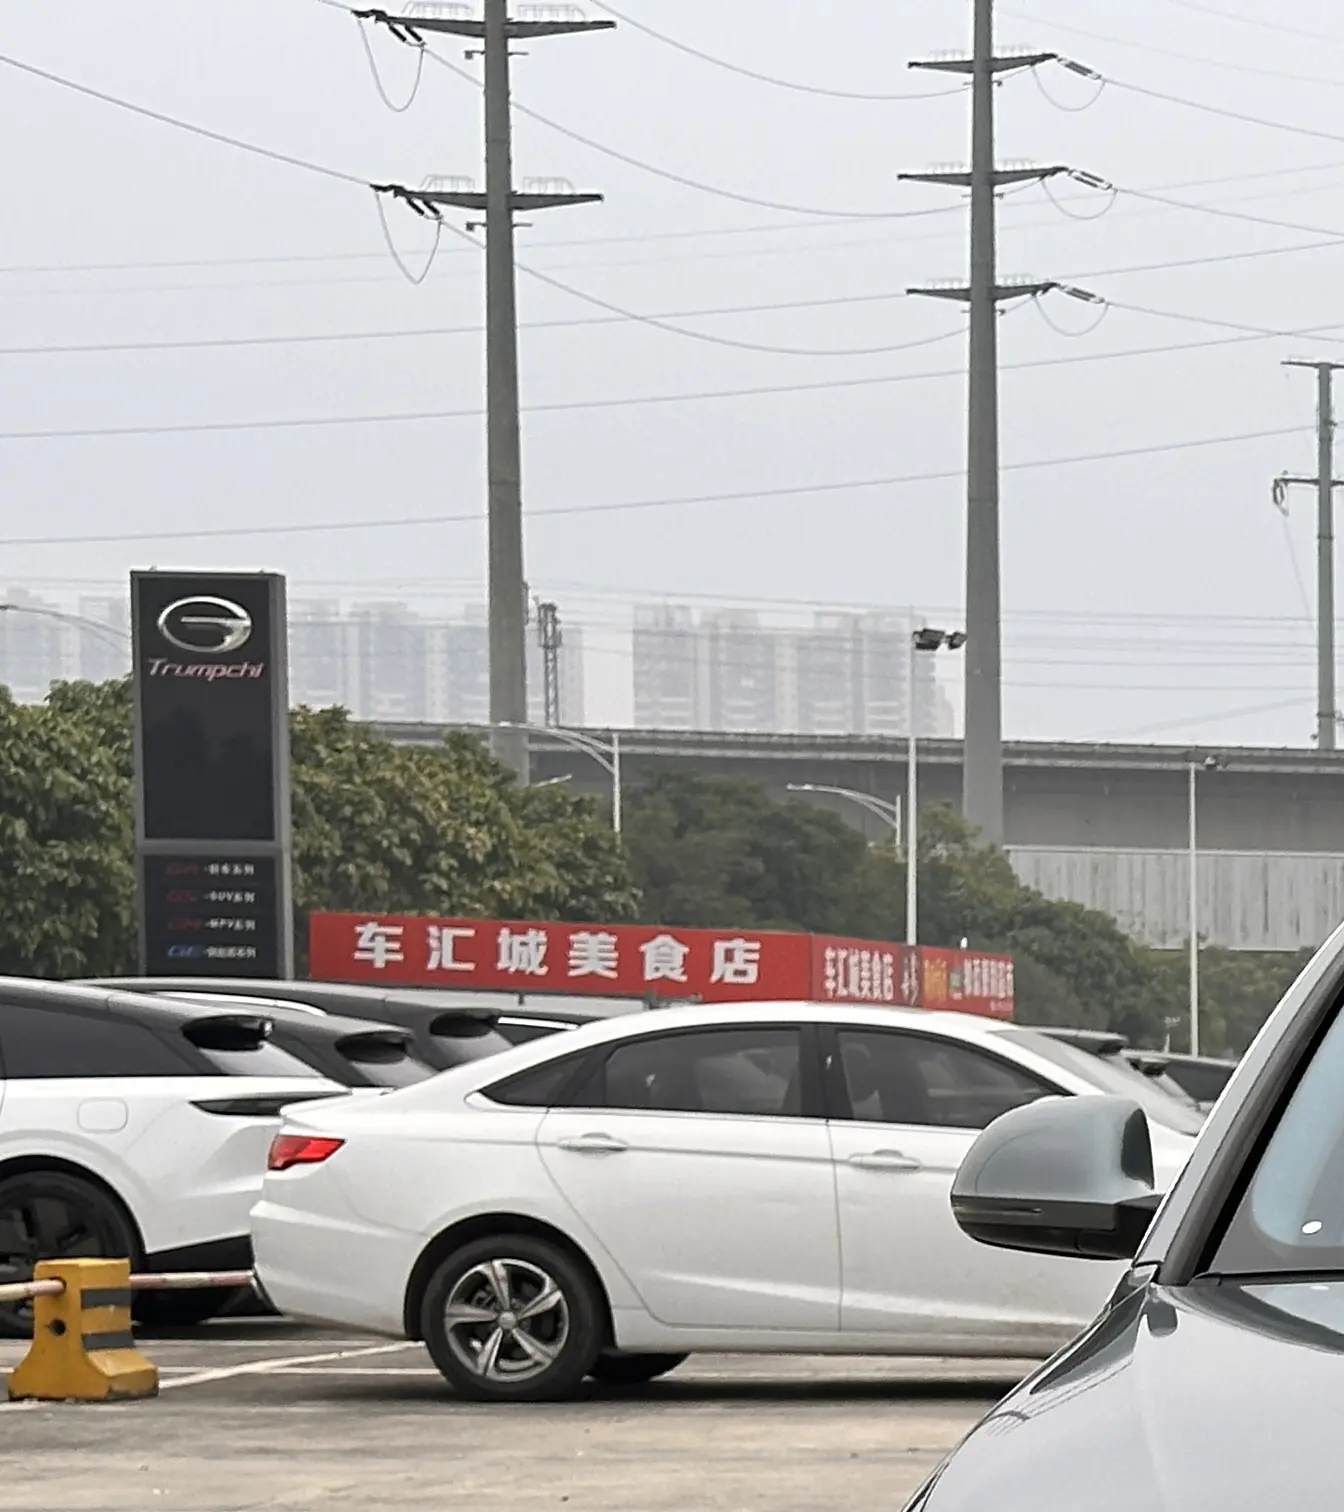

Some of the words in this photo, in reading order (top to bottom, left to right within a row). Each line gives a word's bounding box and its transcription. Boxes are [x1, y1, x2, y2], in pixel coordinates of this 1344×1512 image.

[148, 658, 264, 682] Trumpchi
[354, 921, 762, 985] 车汇城美食店
